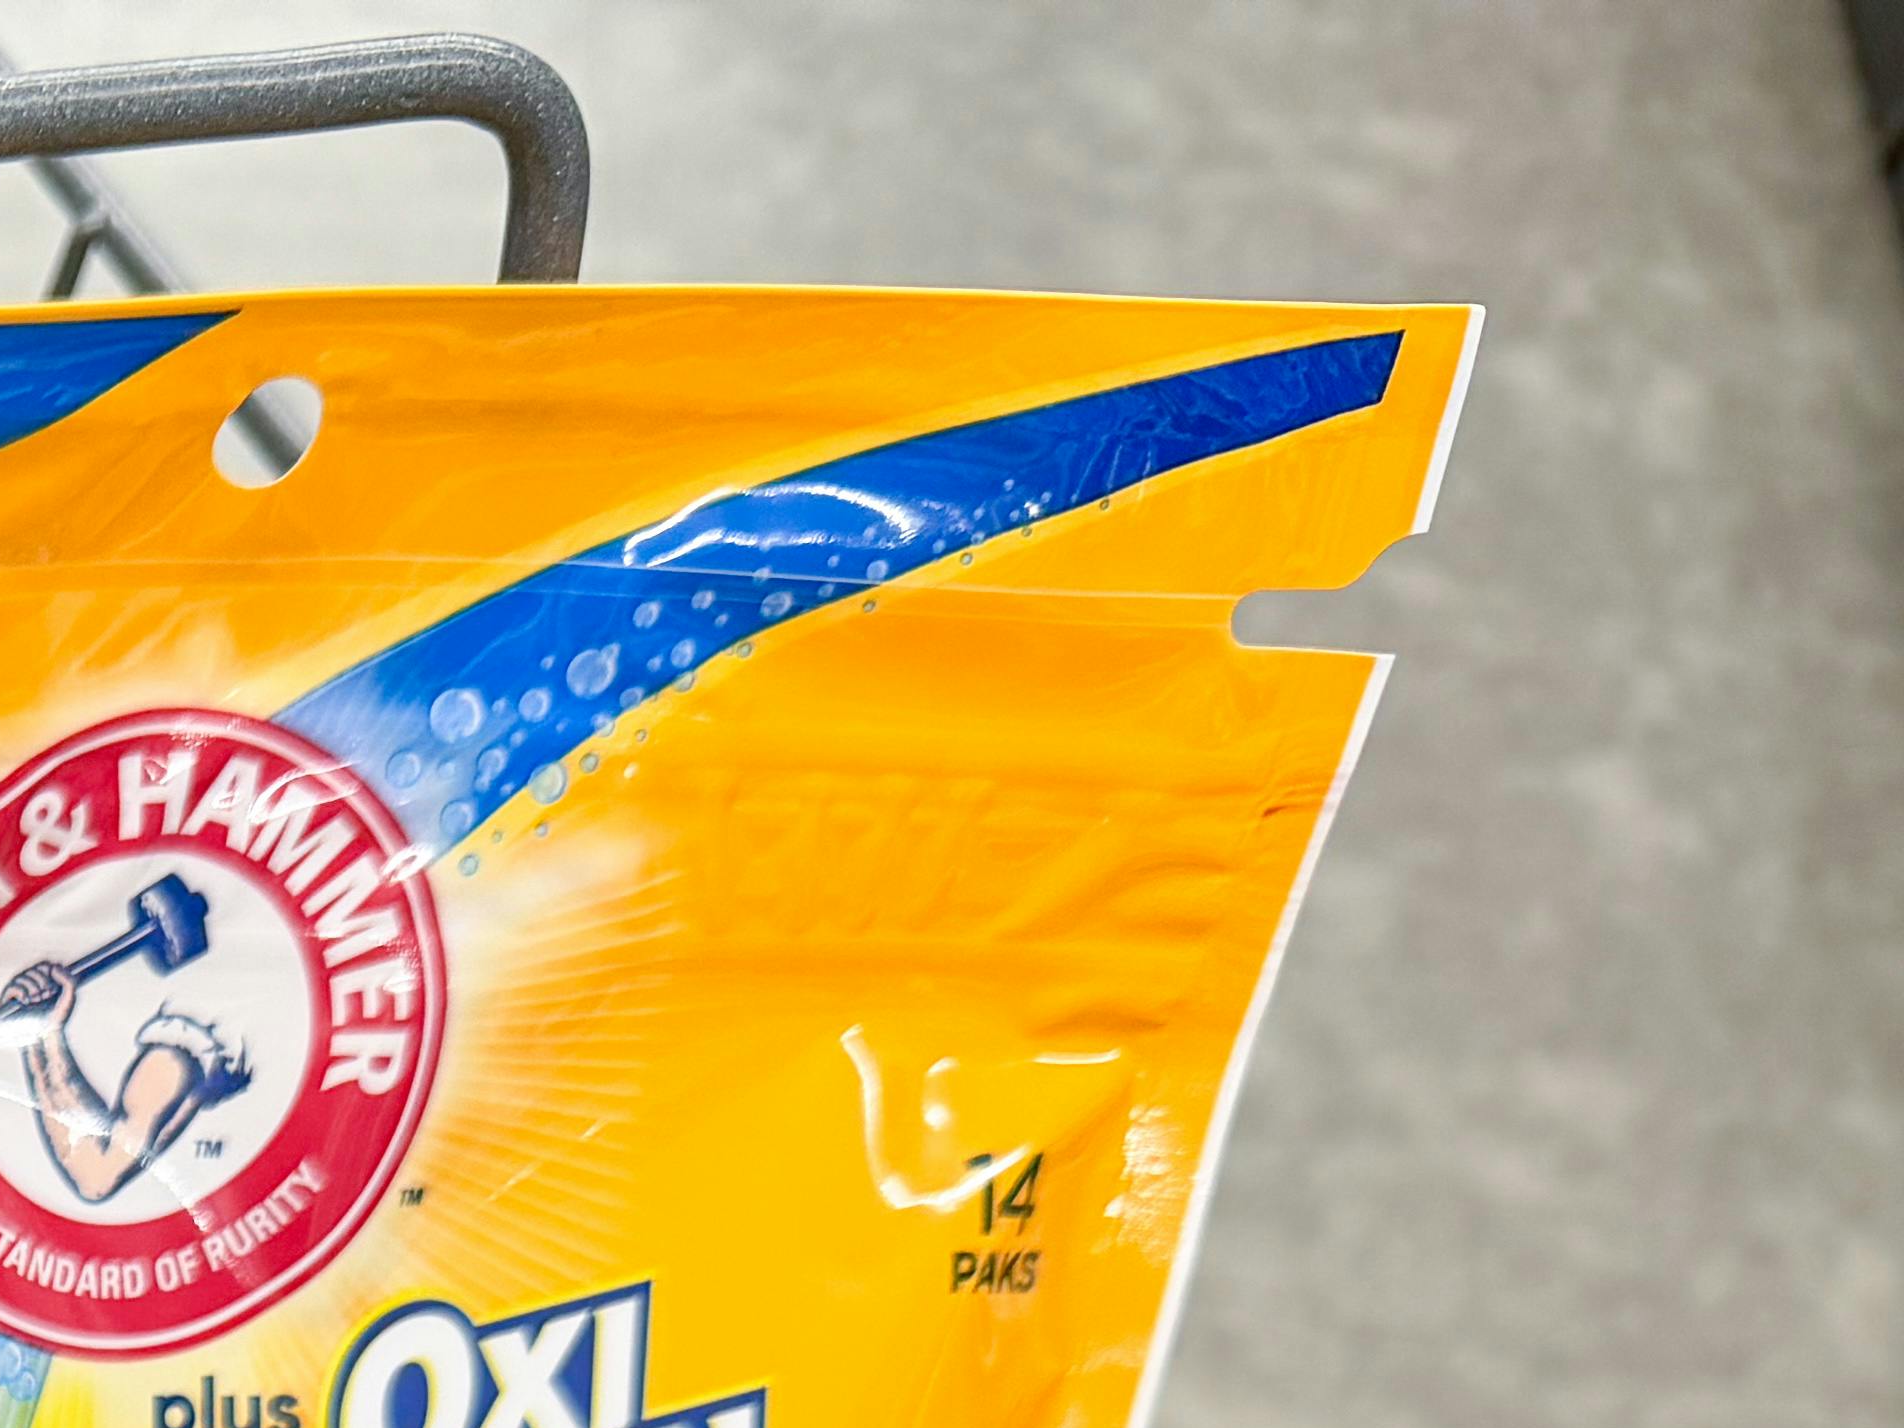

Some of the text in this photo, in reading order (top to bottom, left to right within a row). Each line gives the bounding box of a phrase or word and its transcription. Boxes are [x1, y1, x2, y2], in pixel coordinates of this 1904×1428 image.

[17, 786, 101, 876] &
[117, 750, 420, 1095] HAMMER
[154, 1247, 197, 1292] OF
[208, 1162, 330, 1272] PURITY
[967, 1152, 1043, 1236] 14
[951, 1251, 1040, 1294] PAKS
